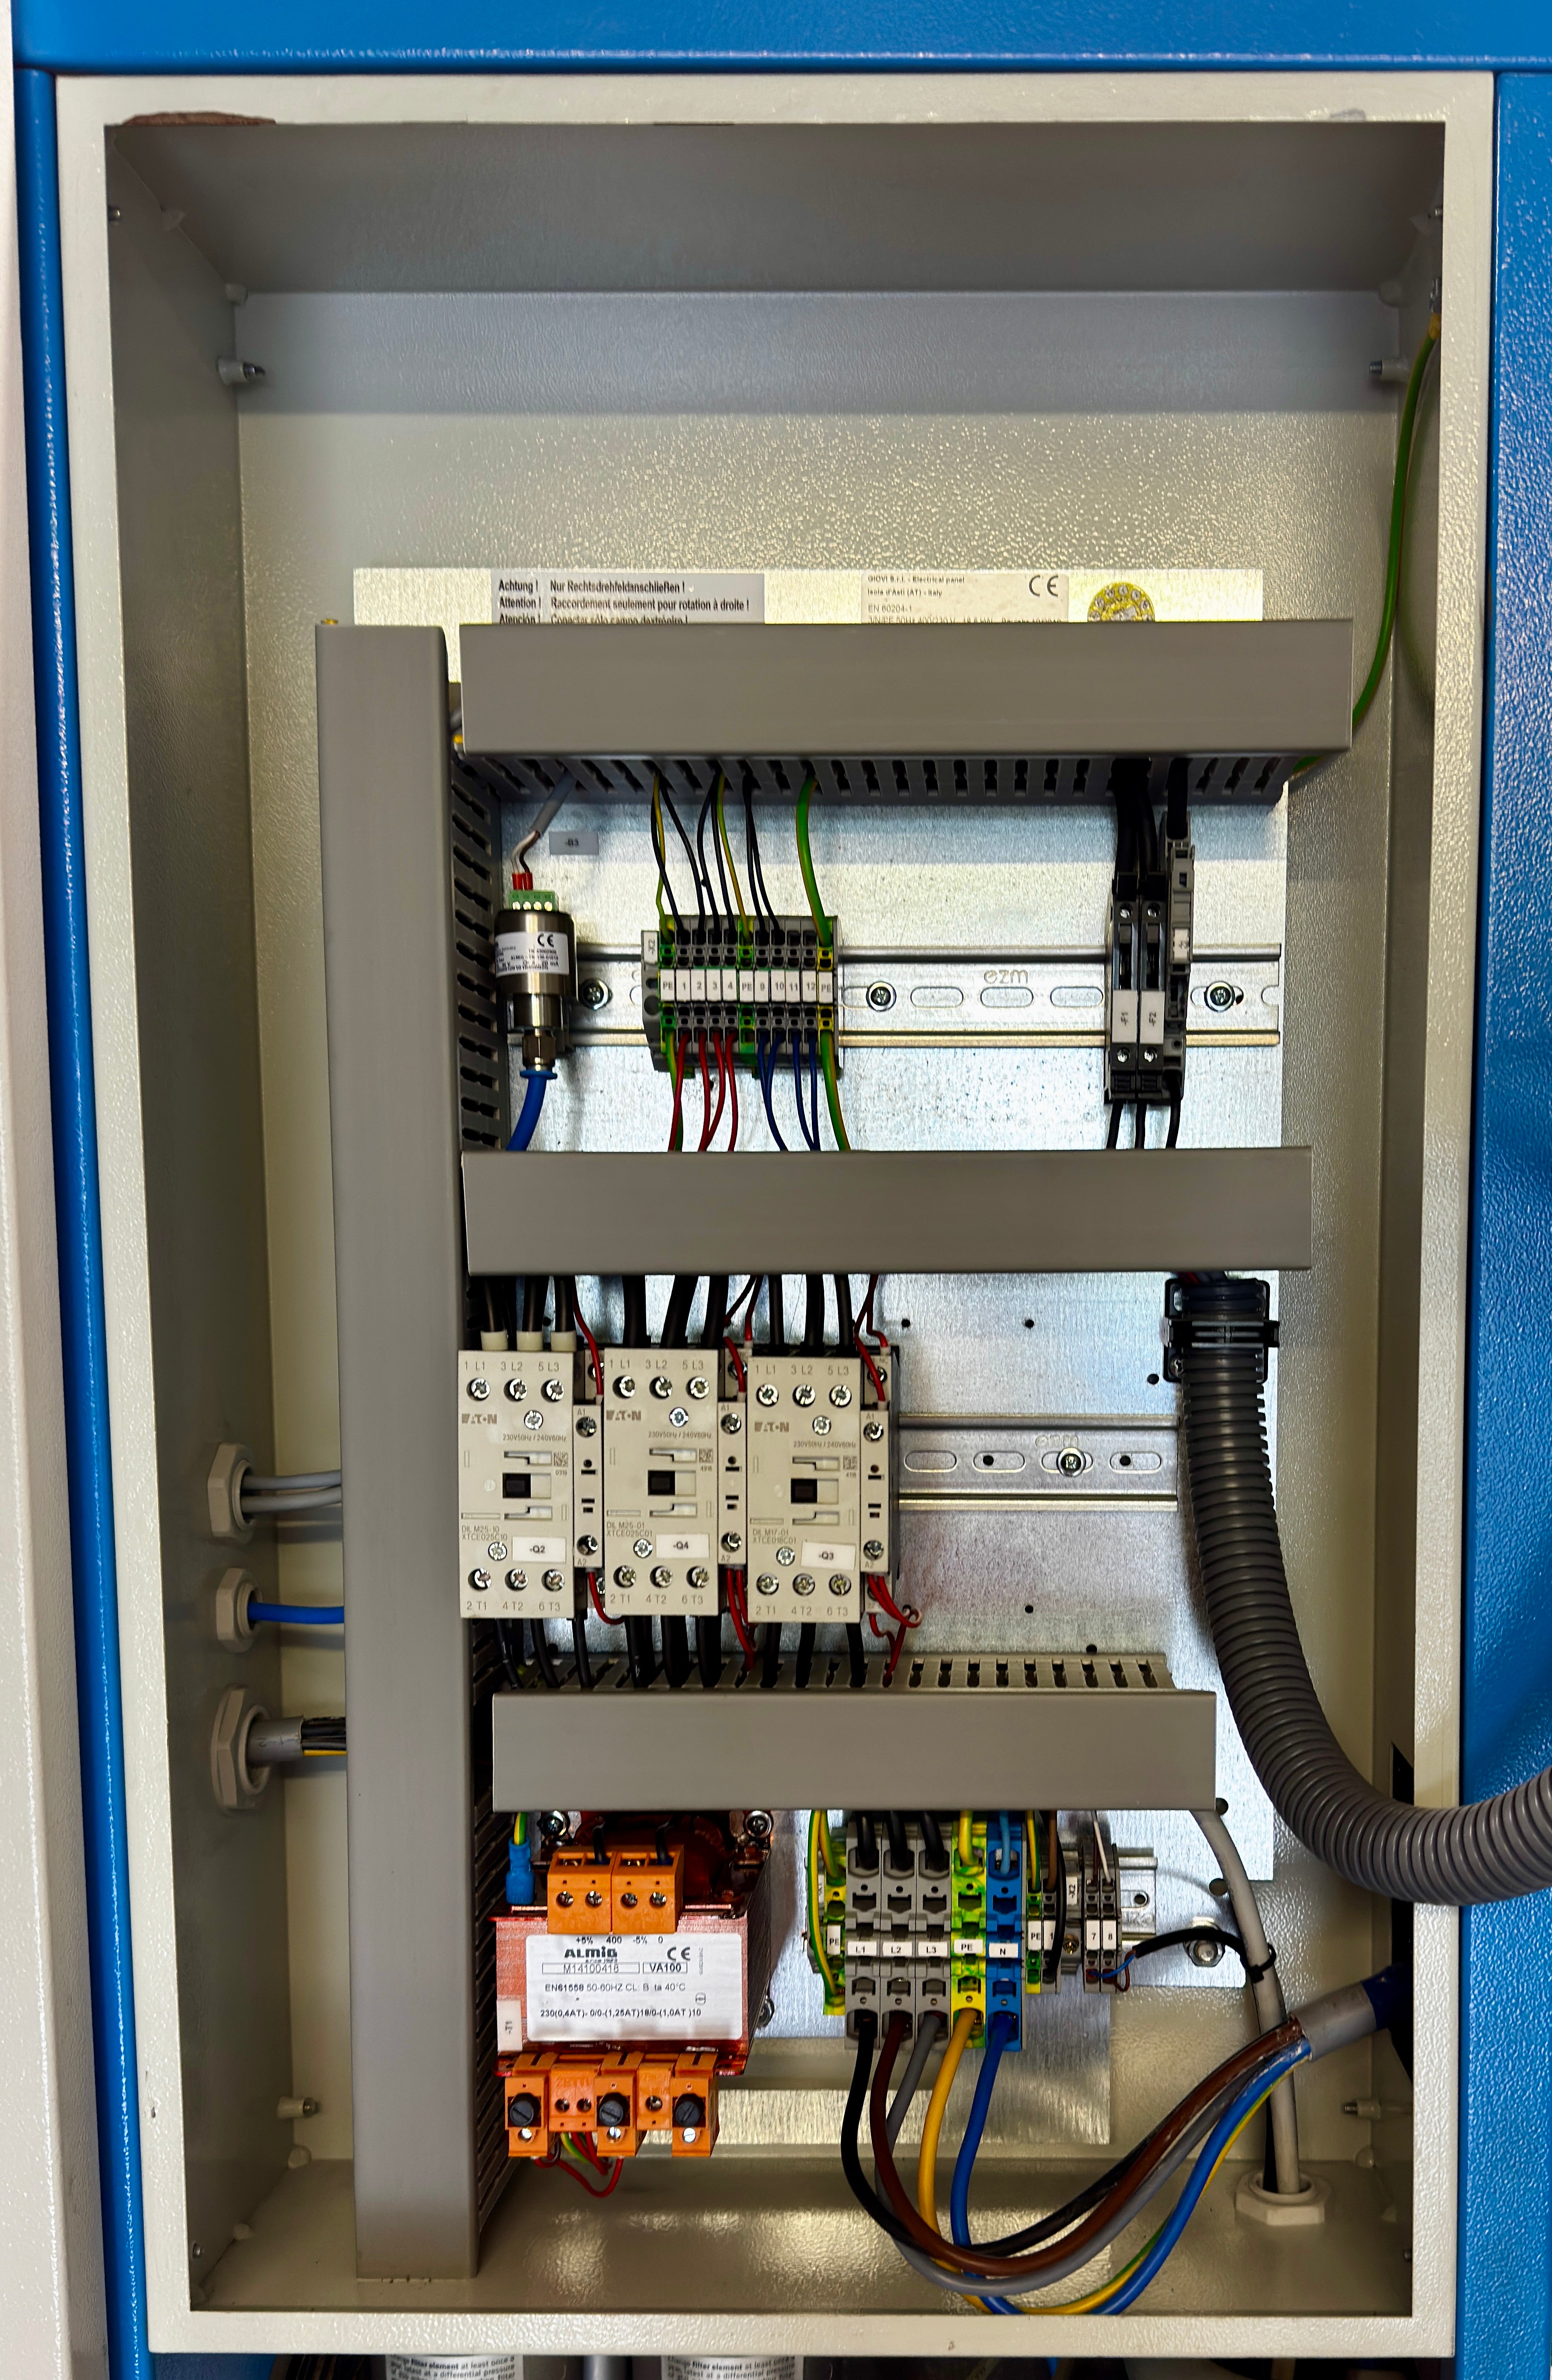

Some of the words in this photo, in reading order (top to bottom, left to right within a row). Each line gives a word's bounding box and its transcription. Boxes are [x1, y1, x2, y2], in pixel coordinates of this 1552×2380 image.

[912, 575, 944, 583] Electrical
[946, 576, 964, 585] panel
[499, 579, 533, 595] Achtung
[551, 579, 564, 592] Nur
[907, 588, 921, 597] (AT)
[928, 589, 942, 598] Italy
[500, 596, 536, 609] Attention
[551, 596, 610, 610] Raccordement
[613, 597, 655, 611] seulement
[658, 600, 676, 613] pour
[679, 598, 711, 611] rotation
[714, 598, 718, 611] à
[721, 598, 744, 611] droite
[868, 603, 879, 613] EN
[882, 604, 912, 613] 60204-1
[663, 982, 673, 990] PE
[683, 982, 686, 990] 1
[697, 982, 702, 990] 2
[713, 982, 717, 990] 3
[728, 981, 733, 990] 4
[742, 982, 752, 991] PE
[775, 981, 784, 991] 10
[789, 982, 798, 991] 11
[806, 982, 816, 991] 12
[821, 983, 831, 993] PE
[465, 1361, 467, 1371] 1
[475, 1361, 485, 1371] L1
[501, 1361, 506, 1371] 3
[512, 1361, 522, 1371] L2
[539, 1362, 544, 1371] 5
[548, 1362, 559, 1372] L3
[610, 1359, 613, 1368] 1
[621, 1359, 630, 1369] L1
[645, 1359, 650, 1369] 3
[656, 1359, 667, 1369] L2
[683, 1360, 688, 1370] 5
[692, 1360, 704, 1370] L3
[756, 1365, 759, 1374] 1
[766, 1365, 776, 1374] L1
[791, 1365, 796, 1375] 3
[802, 1365, 813, 1375] L2
[828, 1366, 833, 1375] 5
[838, 1366, 849, 1375] L3
[529, 1545, 545, 1554] -Q2
[673, 1541, 689, 1550] -Q4
[818, 1551, 834, 1560] -Q3
[610, 1594, 615, 1603] 2
[621, 1594, 630, 1603] T1
[646, 1594, 651, 1603] 4
[656, 1594, 667, 1604] T2
[682, 1595, 687, 1604] 6
[692, 1595, 703, 1605] T3
[467, 1602, 472, 1610] 2
[477, 1601, 487, 1610] T1
[503, 1601, 507, 1610] 4
[512, 1602, 523, 1611] T2
[539, 1602, 544, 1611] 6
[549, 1602, 560, 1611] T3
[756, 1606, 761, 1615] 2
[766, 1606, 776, 1615] T1
[792, 1606, 796, 1615] 4
[801, 1606, 811, 1616] T2
[827, 1606, 832, 1616] 6
[837, 1606, 848, 1616] T3
[576, 1936, 593, 1945] +5%
[606, 1936, 622, 1944] 400
[633, 1936, 647, 1945] -5%
[658, 1936, 663, 1944] 0
[830, 1937, 840, 1945] PE
[1031, 1932, 1040, 1940] PE
[1092, 1932, 1096, 1940] 7
[564, 1963, 619, 1974] M14100418
[649, 1963, 682, 1973] VA100
[587, 1983, 623, 1992] 50-60HZ
[643, 1983, 649, 1991] B
[654, 1983, 662, 1991] ta
[665, 1983, 685, 1992] 40°C
[411, 2358, 427, 2367] filter
[471, 2361, 488, 2369] least
[491, 2357, 508, 2366] once
[693, 2360, 709, 2369] filter
[440, 2369, 481, 2378] differential
[484, 2363, 515, 2376] pressure
[723, 2369, 763, 2380] differential
